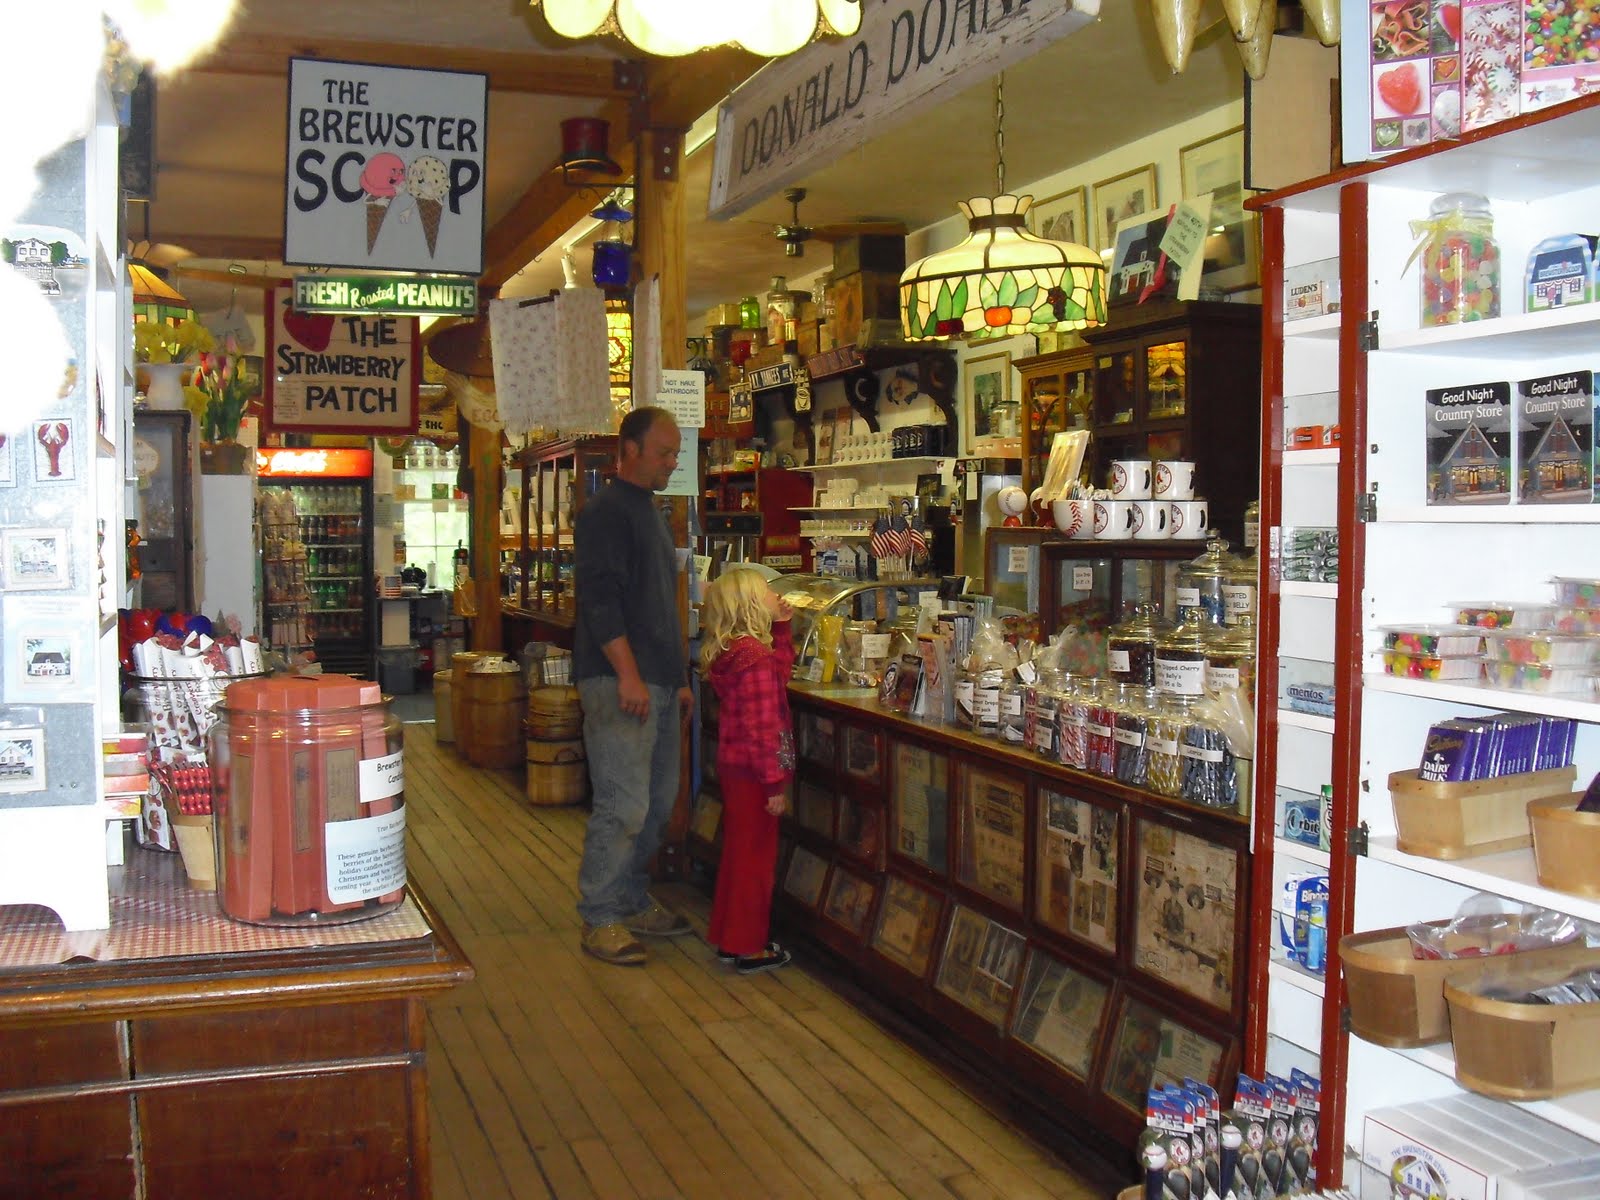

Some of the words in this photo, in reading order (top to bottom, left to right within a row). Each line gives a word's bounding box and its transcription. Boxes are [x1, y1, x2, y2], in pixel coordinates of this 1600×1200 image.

[323, 79, 369, 105] THE
[739, 39, 870, 178] DONALD
[300, 107, 478, 152] BREWSTER
[296, 281, 348, 305] FRESH
[350, 283, 396, 308] Roasted
[397, 282, 474, 308] PEANUTS
[1290, 283, 1318, 296] LUDEN'S
[342, 316, 397, 347] THE
[277, 344, 406, 381] STRAWBERRY
[1531, 381, 1552, 395] Good
[1553, 376, 1578, 394] Night
[306, 386, 397, 414] PATCH
[1442, 390, 1465, 404] Good
[1467, 387, 1494, 403] Night
[1435, 408, 1474, 424] Country
[1476, 405, 1503, 419] Store
[1525, 400, 1559, 416] Country
[1562, 396, 1586, 410] Store
[1289, 686, 1324, 700] mentos
[377, 759, 401, 772] Brewster
[1423, 760, 1450, 773] DAIRY
[1421, 770, 1448, 782] MILK
[1286, 807, 1320, 838] Orbit
[338, 874, 369, 883] Christmas
[339, 868, 362, 876] holiday
[364, 863, 383, 871] candles
[334, 883, 358, 891] coming
